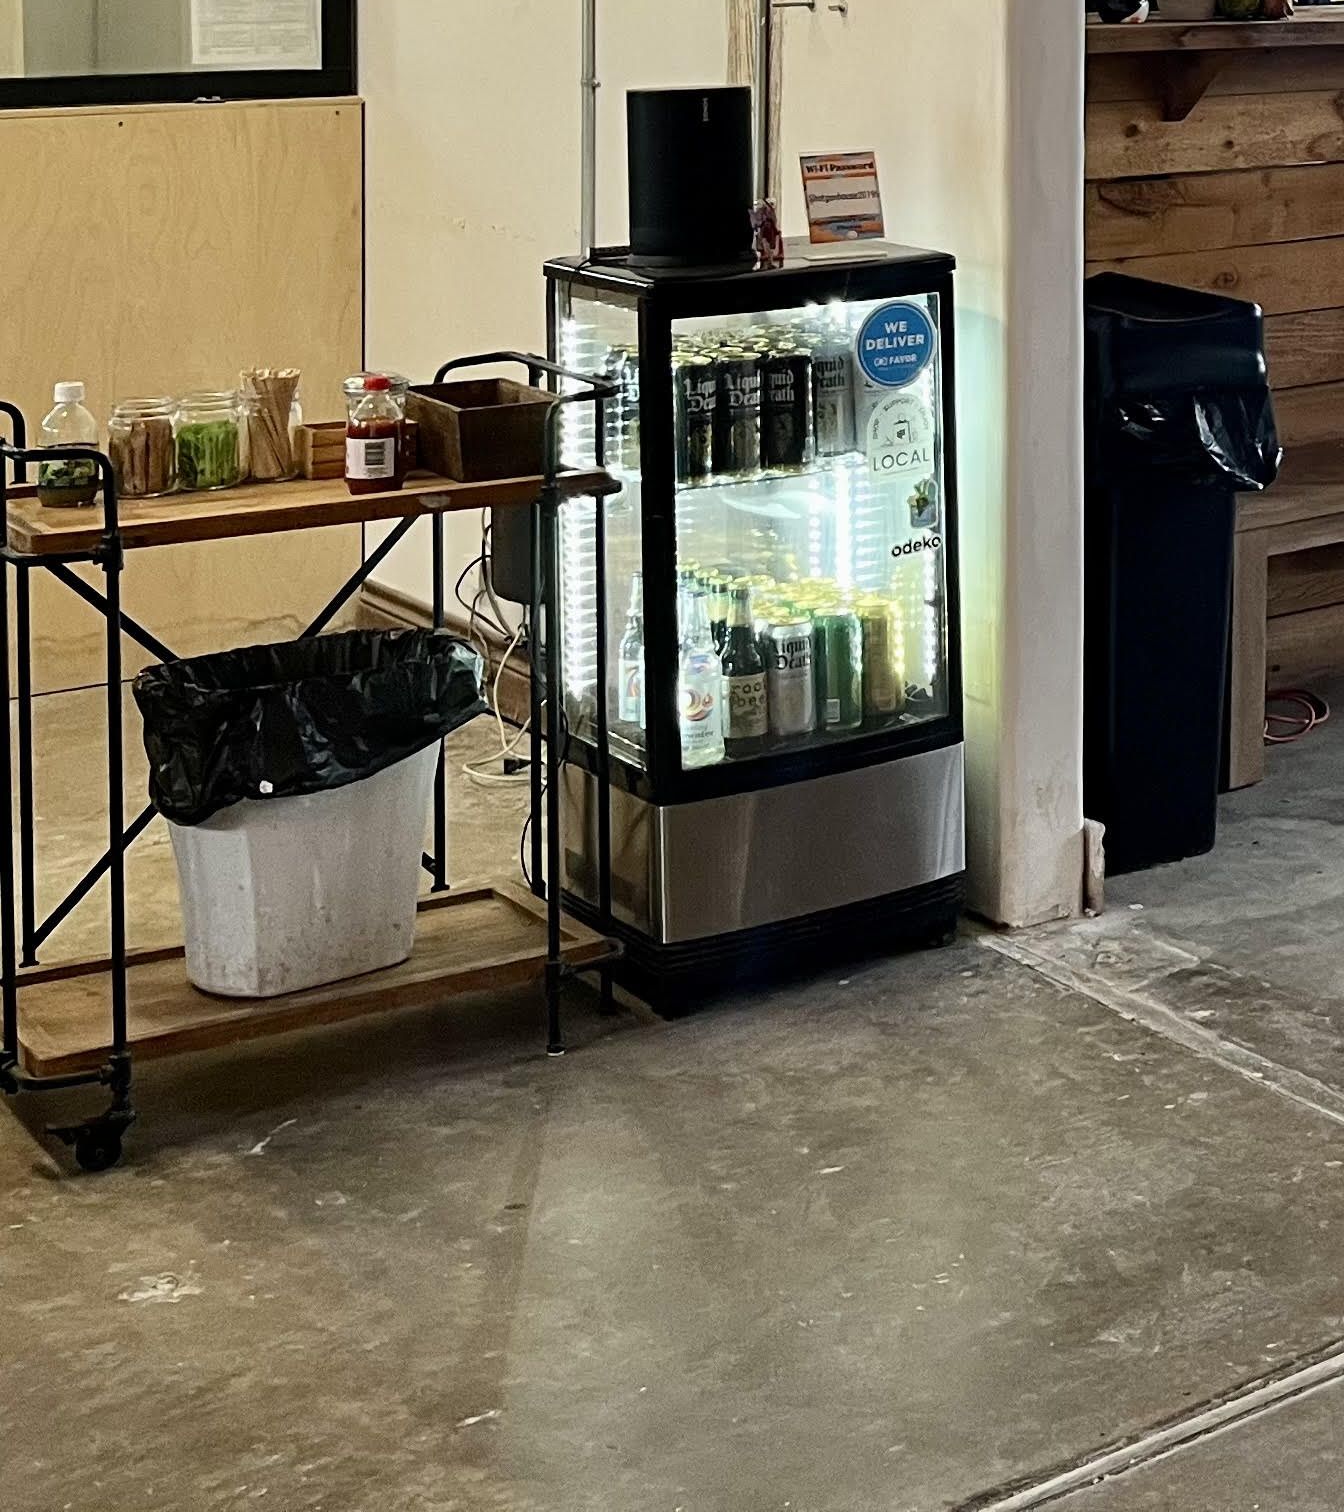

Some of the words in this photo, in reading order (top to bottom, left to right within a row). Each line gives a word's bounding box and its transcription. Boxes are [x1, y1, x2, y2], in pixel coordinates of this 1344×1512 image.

[884, 321, 907, 334] WE
[865, 334, 925, 351] DELIVER
[873, 447, 929, 472] LOCAL
[892, 535, 941, 557] odeko
